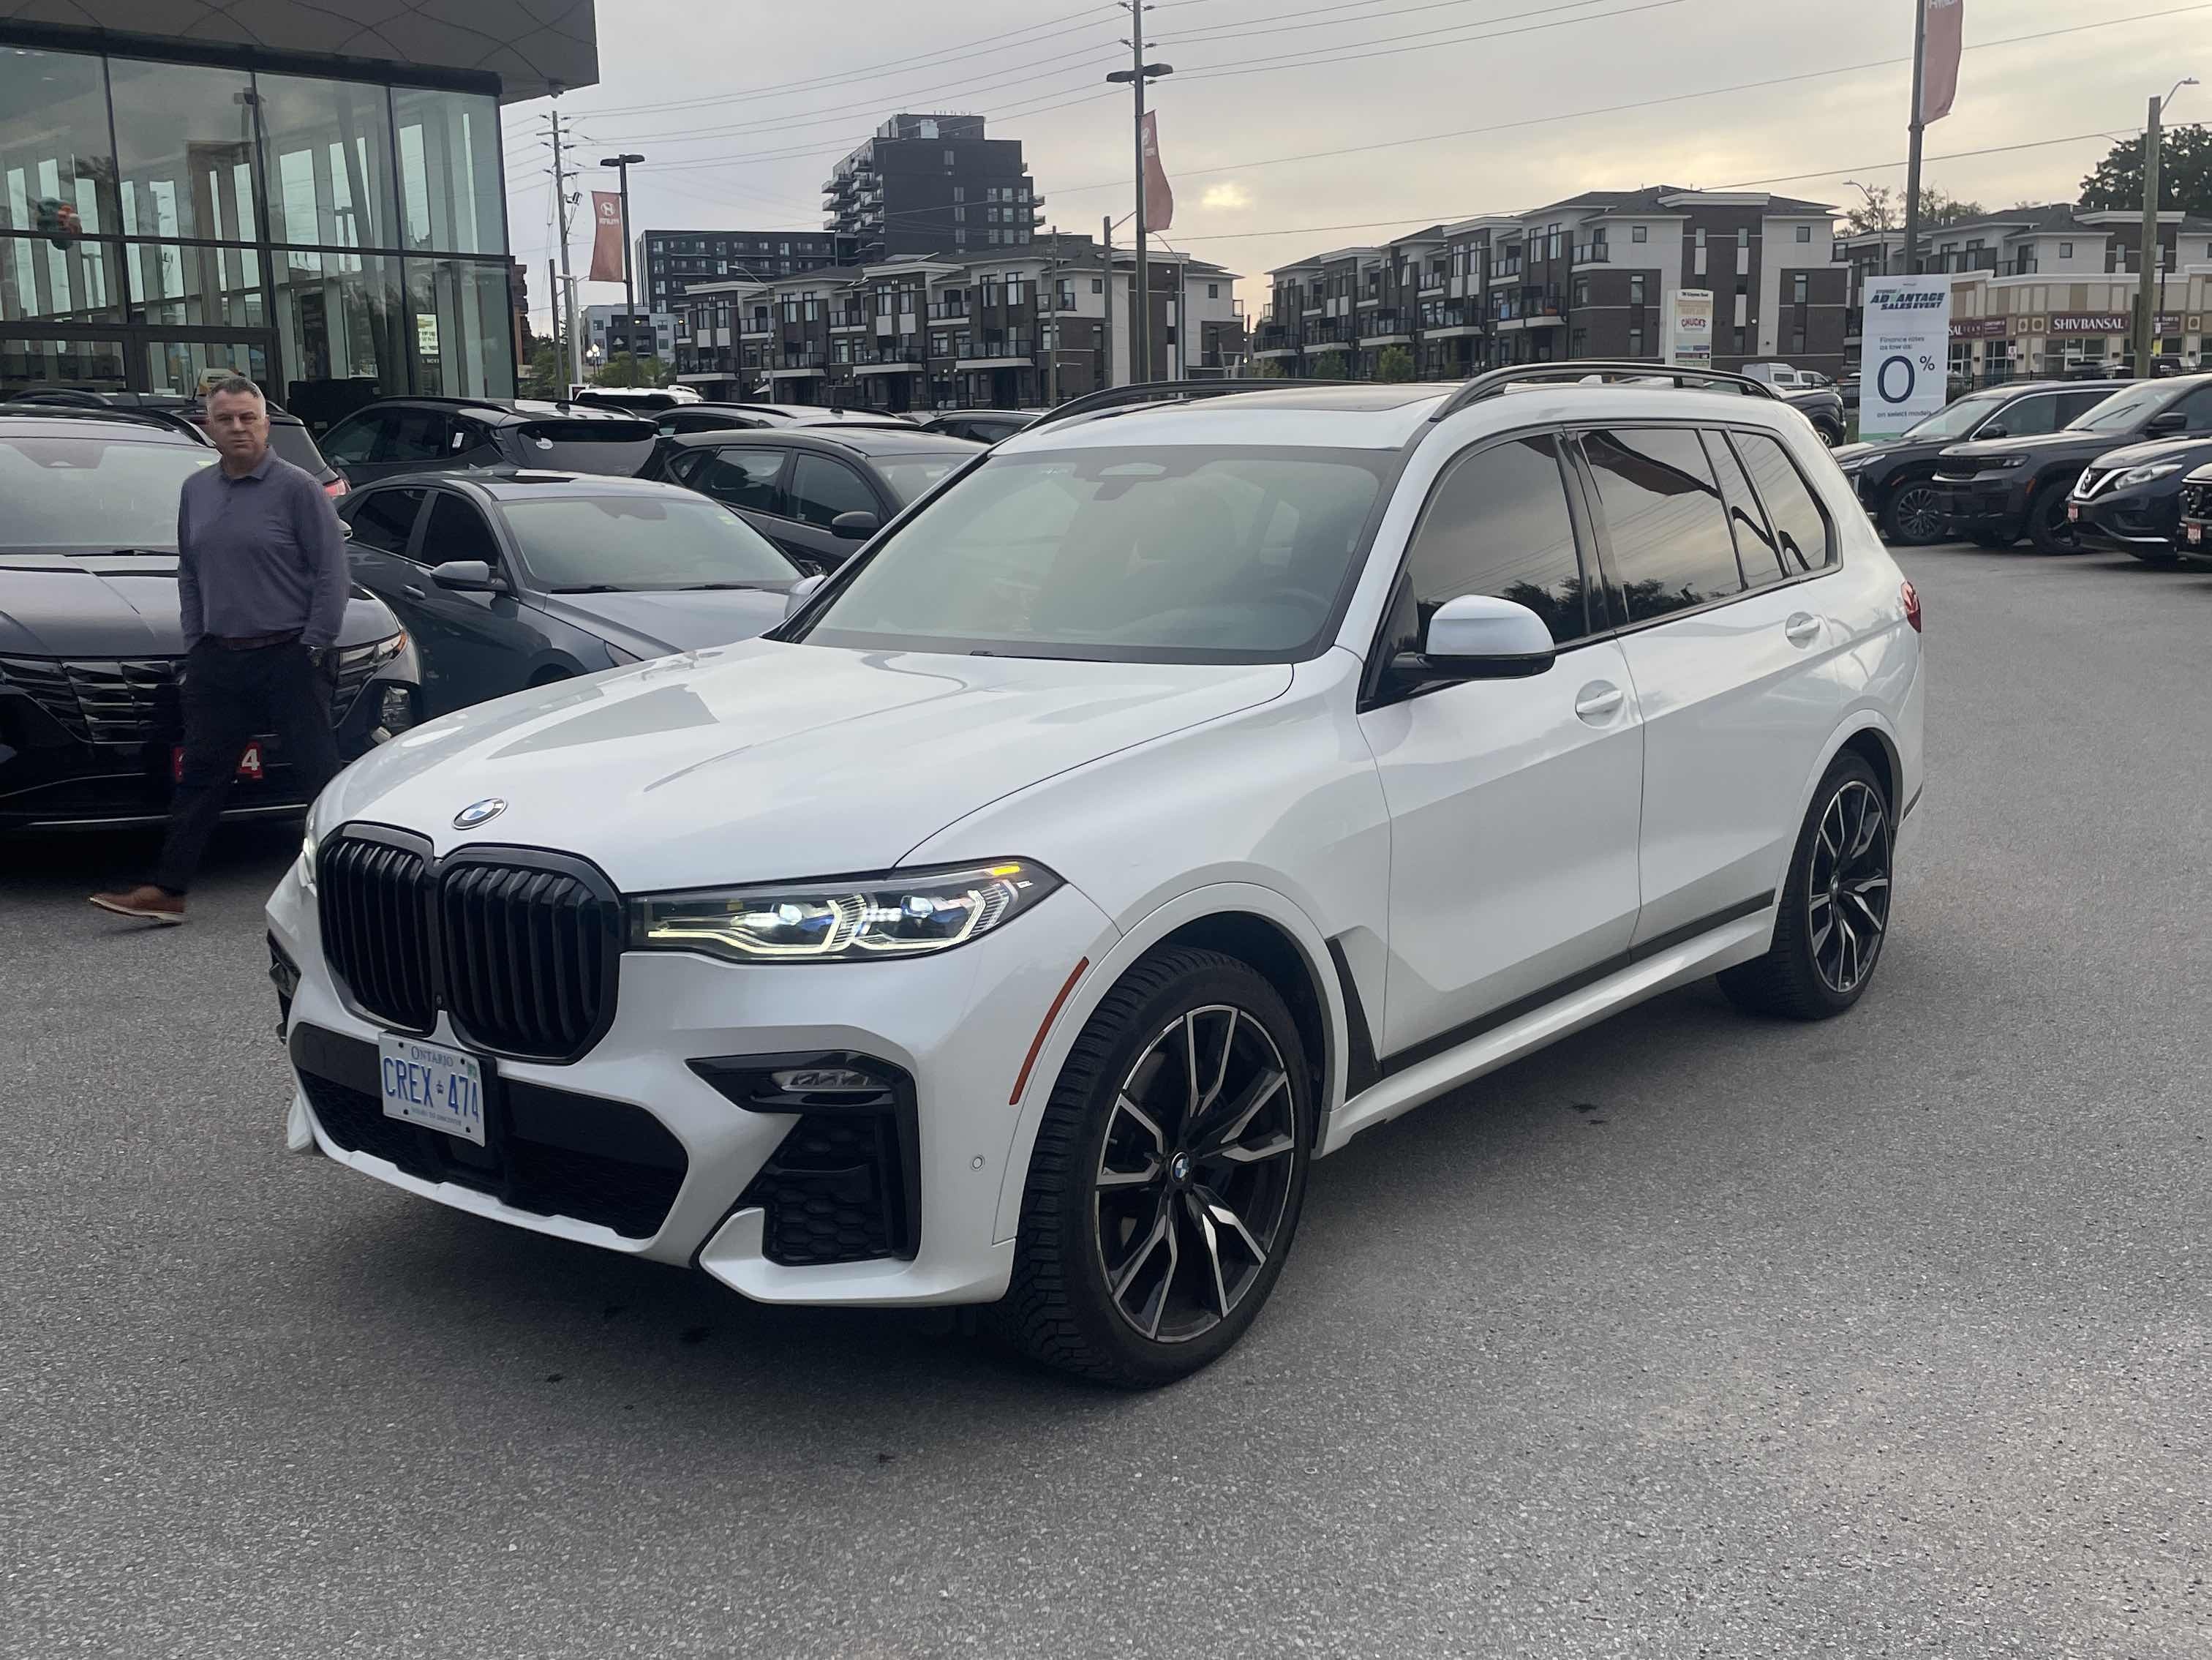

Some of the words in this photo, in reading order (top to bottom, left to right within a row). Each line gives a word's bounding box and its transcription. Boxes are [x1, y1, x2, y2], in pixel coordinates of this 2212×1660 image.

[1881, 302, 1912, 310] SALES
[1913, 301, 1942, 309] EVENT
[2053, 317, 2083, 331] SHIV
[2082, 317, 2124, 330] BANSAL
[411, 1045, 454, 1068] ONTARIO
[383, 1056, 434, 1108] CREX
[448, 1072, 480, 1124] 474
